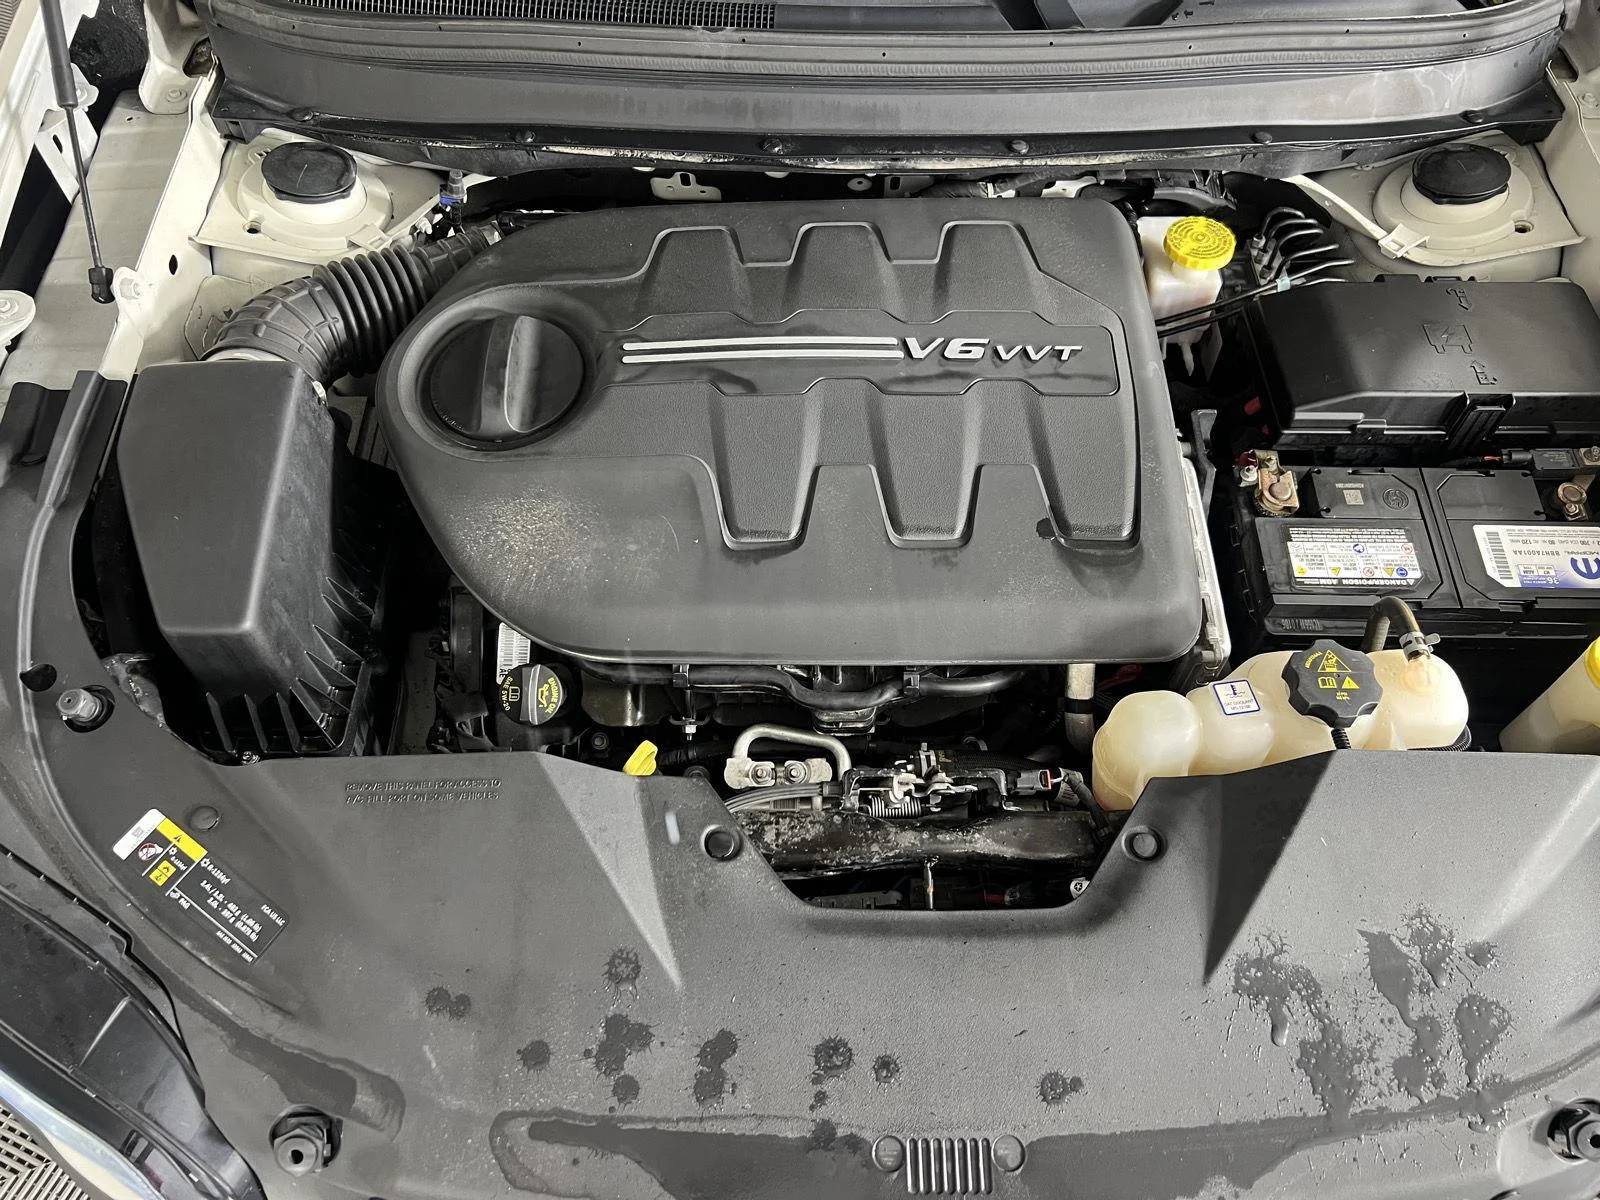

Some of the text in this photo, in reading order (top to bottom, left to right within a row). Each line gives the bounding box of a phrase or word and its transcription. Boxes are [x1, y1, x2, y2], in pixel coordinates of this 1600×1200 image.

[904, 337, 1083, 361] V6 VVT
[503, 677, 513, 689] SAE
[502, 690, 510, 711] 5W-20
[545, 677, 559, 714] ENGINE OIL
[346, 780, 501, 791] REMOVE THIS PANEL FOR ACCESS TO
[388, 794, 411, 802] PORT
[414, 794, 427, 802] ON
[430, 793, 454, 801] SOME
[275, 916, 286, 926] LLC
